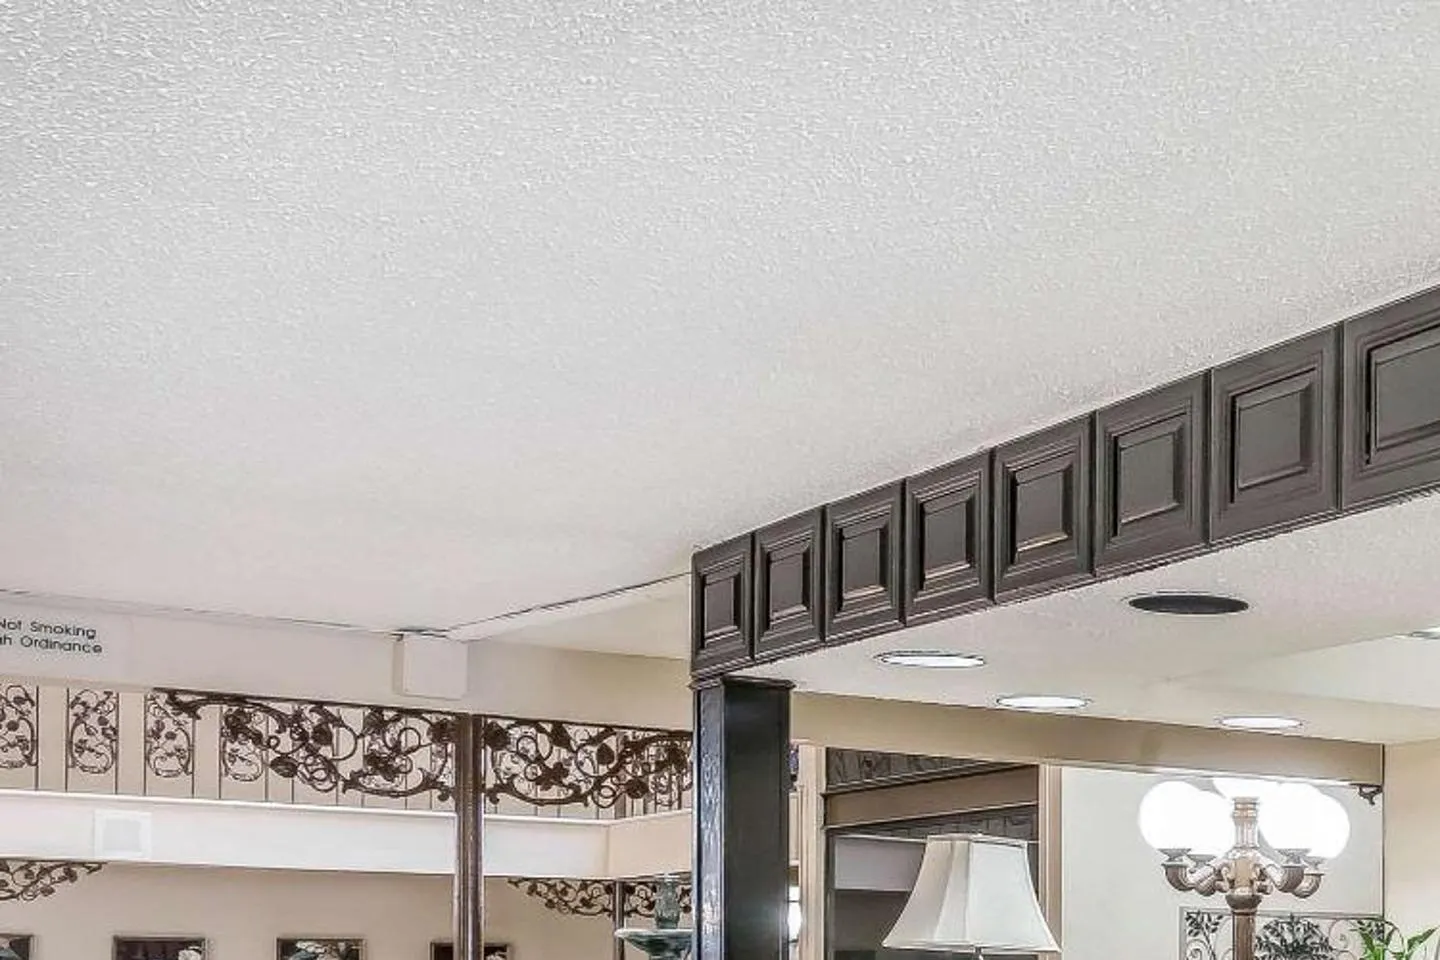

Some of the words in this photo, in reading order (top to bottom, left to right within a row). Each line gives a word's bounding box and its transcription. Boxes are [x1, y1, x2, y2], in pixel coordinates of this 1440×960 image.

[30, 621, 96, 639] Smoking
[0, 634, 12, 645] h
[20, 635, 102, 653] Ordinance
